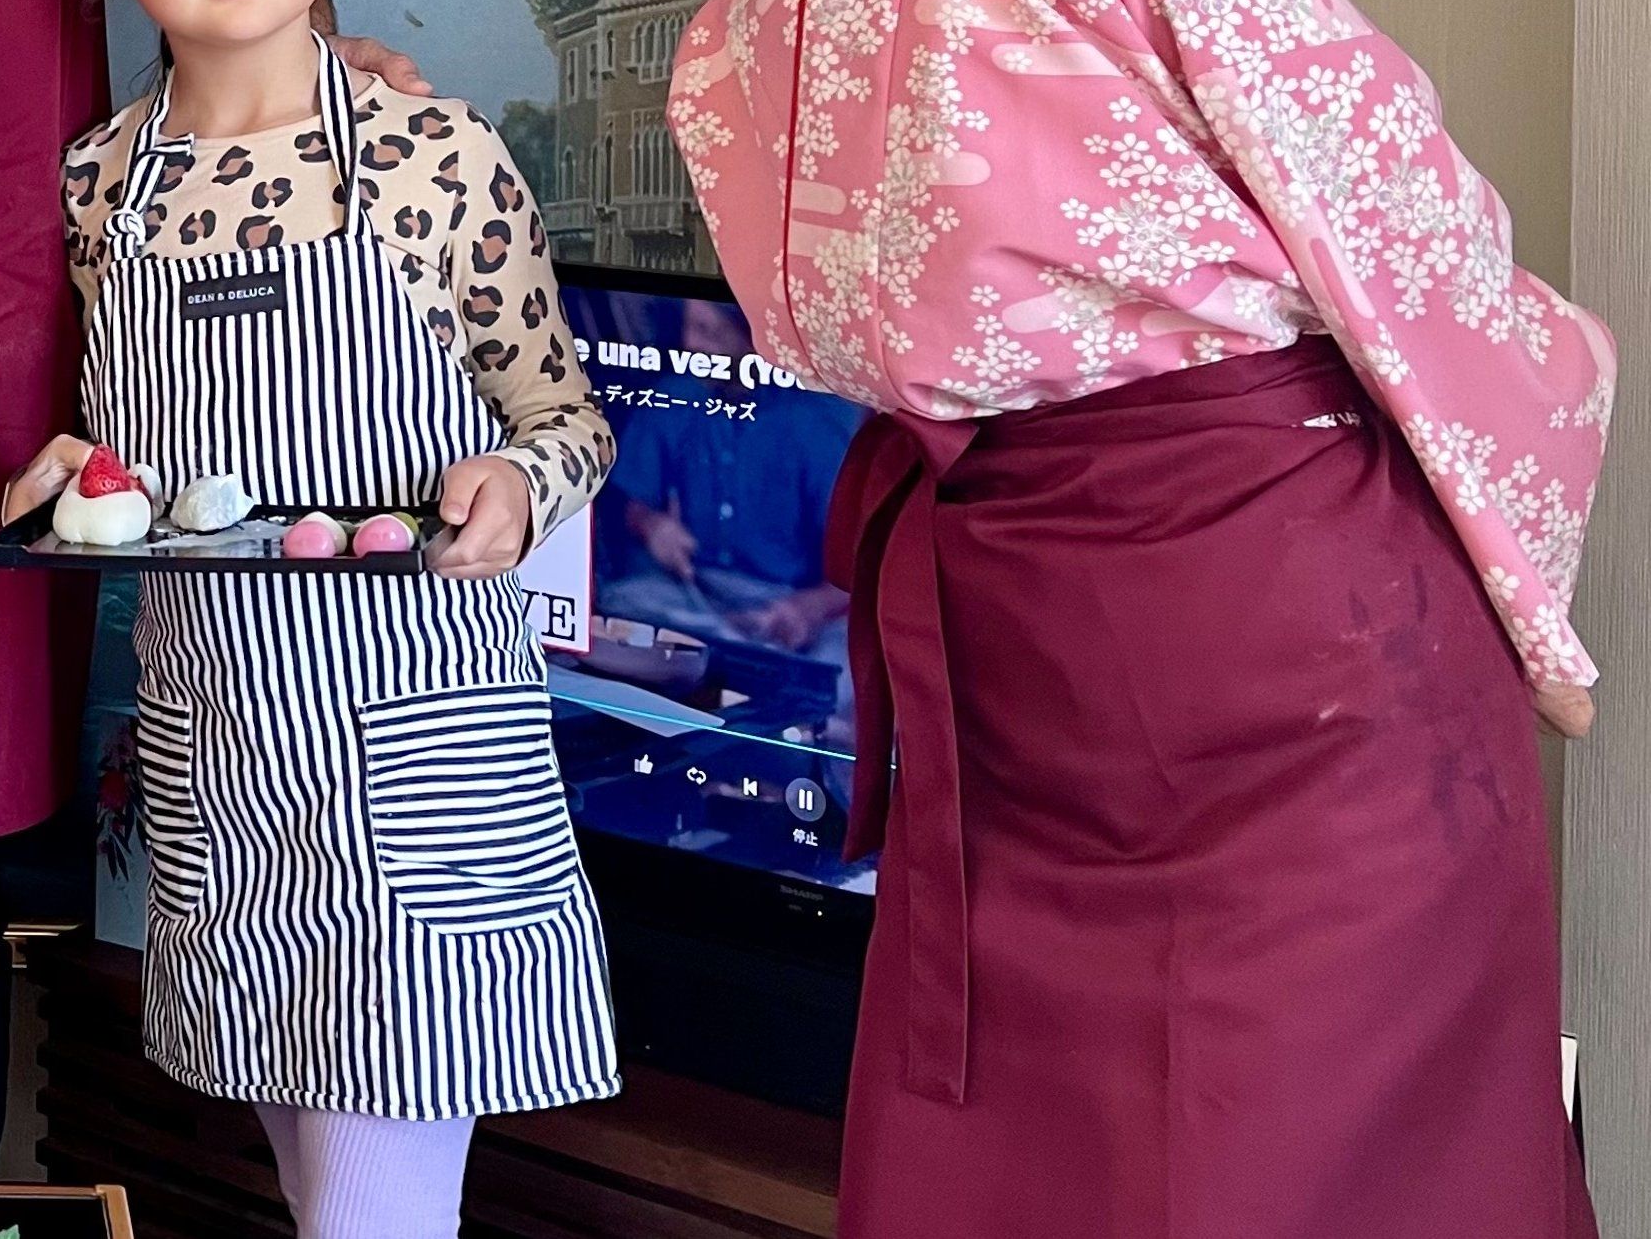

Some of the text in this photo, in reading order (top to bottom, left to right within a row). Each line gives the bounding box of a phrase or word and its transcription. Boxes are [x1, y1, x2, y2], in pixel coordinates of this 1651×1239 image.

[187, 285, 275, 305] DEAN & DELUCA
[598, 340, 661, 372] una
[668, 349, 732, 381] vez
[738, 353, 806, 390] (Yo
[605, 384, 757, 422] ディズニー・ジャズ
[792, 828, 819, 847] 停止
